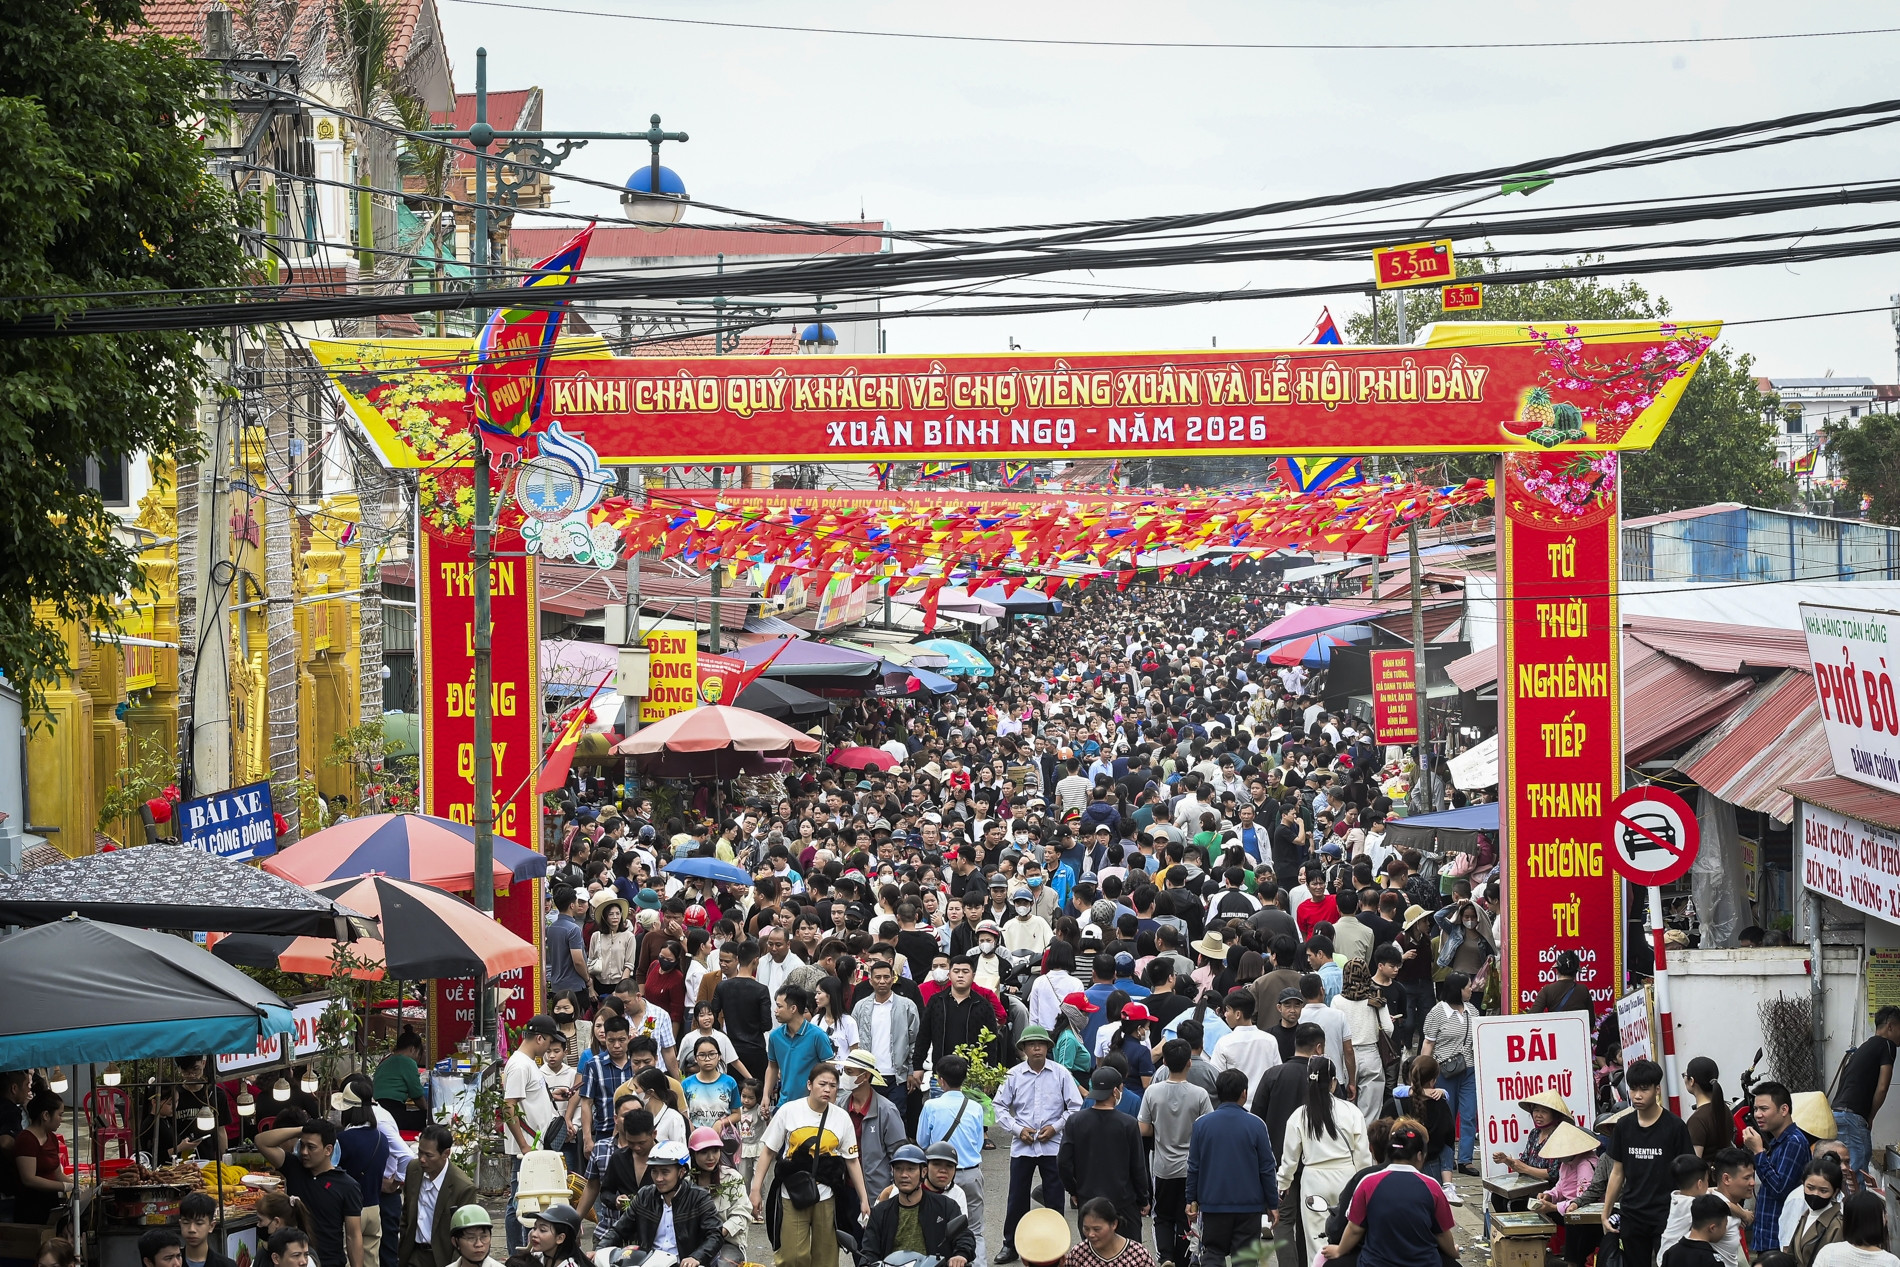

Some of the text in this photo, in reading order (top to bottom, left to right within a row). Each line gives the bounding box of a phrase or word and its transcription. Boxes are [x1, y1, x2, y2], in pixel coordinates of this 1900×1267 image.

[1391, 255, 1437, 276] 5.5m
[1450, 292, 1474, 304] 5.5m
[552, 353, 1489, 419] KÍNH CHÀO QUÝ KHÁCH VỀ CHỢ VIỀNG XUÂN VÀ LỄ HỘI PHỦ DẦY
[827, 415, 913, 447] XUÂN
[924, 414, 999, 446] BÍNH
[1011, 418, 1076, 449] NGỌ
[1108, 411, 1175, 443] NĂM
[1186, 415, 1266, 442] 2026
[1548, 534, 1577, 578] TỨ
[1536, 595, 1588, 638] THỜI
[1820, 613, 1843, 638] HÀNG
[649, 659, 692, 679] ÔNG
[1518, 655, 1608, 698] NGHÊNH
[1814, 645, 1899, 737] PHỞ BÒ
[643, 706, 665, 719] Phủ
[1541, 709, 1587, 758] TIẾP
[1850, 744, 1873, 778] BÁNH
[1873, 747, 1899, 784] CUỐN
[188, 790, 262, 830] BÃI XE
[1527, 782, 1602, 818] THANH
[209, 828, 241, 855] CÔNG
[241, 816, 273, 847] ĐỒNG
[1805, 813, 1829, 852] BÁNH
[1830, 820, 1854, 860] CUỐN
[1527, 837, 1603, 878] HƯƠNG
[1806, 853, 1824, 890] BÚN
[1826, 859, 1844, 897] CHẢ
[1552, 893, 1581, 937] TỬ
[446, 982, 464, 1001] VỀ
[1538, 964, 1597, 982] ĐÓ IẾP
[1506, 1028, 1558, 1063] BÃI
[1497, 1068, 1573, 1101] TRÔNG GIỮ
[1488, 1114, 1498, 1145] Ô
[1501, 1113, 1519, 1143] TÔ
[1628, 1147, 1663, 1156] ESSENTIALS
